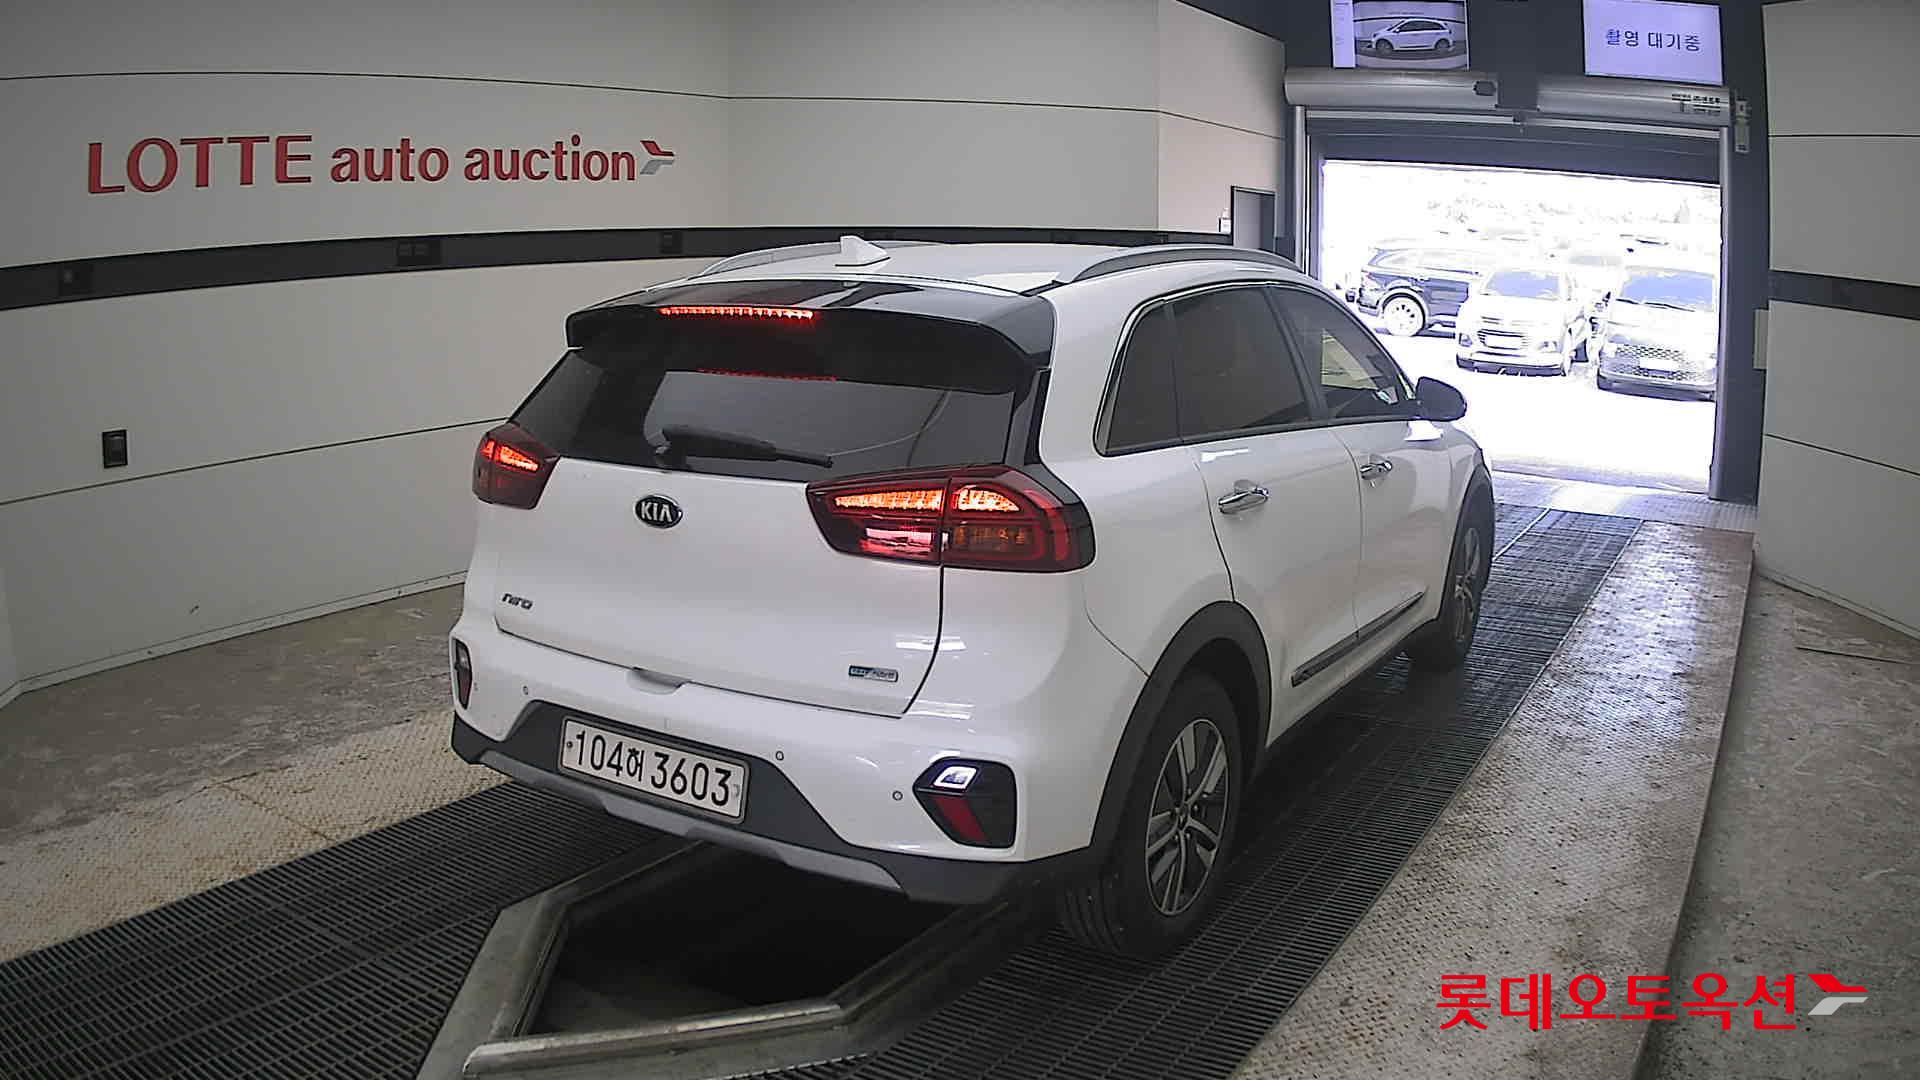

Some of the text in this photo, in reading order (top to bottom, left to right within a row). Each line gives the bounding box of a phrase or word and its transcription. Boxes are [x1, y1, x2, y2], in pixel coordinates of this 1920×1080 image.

[1647, 31, 1701, 52] 대기중
[88, 134, 636, 194] LOTTE auto auction
[640, 502, 673, 524] KIA
[576, 730, 734, 806] 104허 3603
